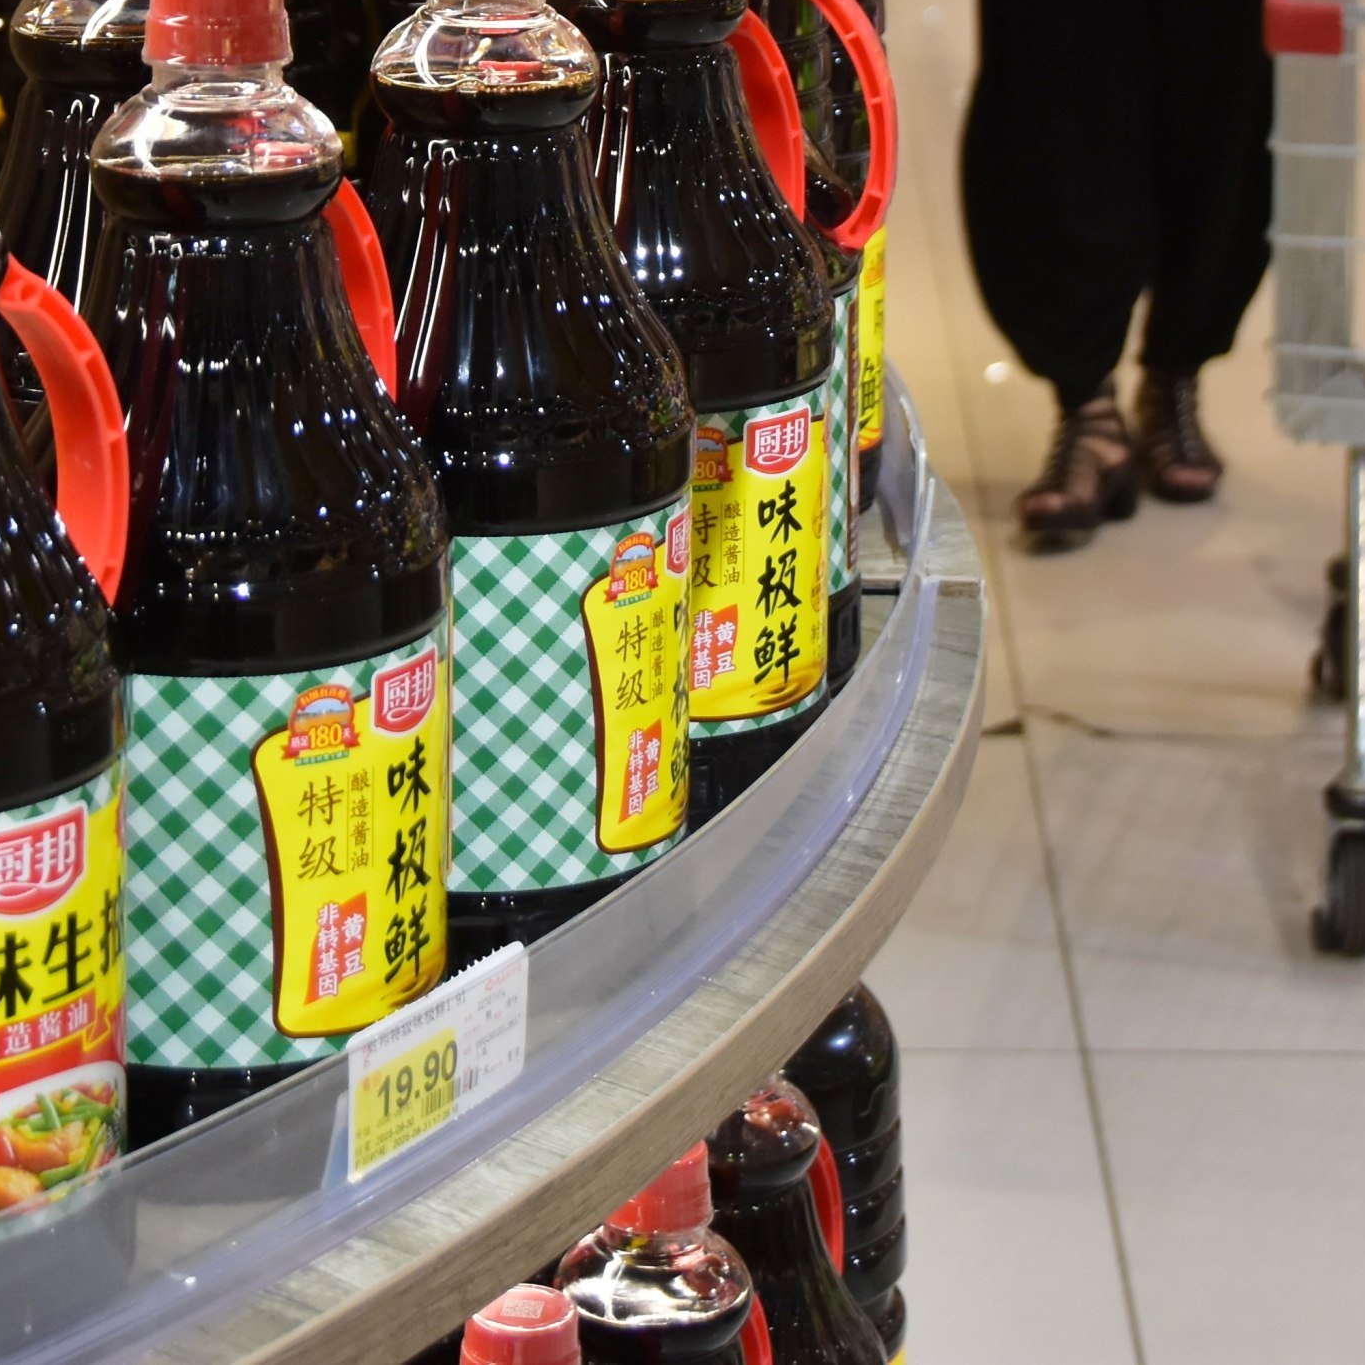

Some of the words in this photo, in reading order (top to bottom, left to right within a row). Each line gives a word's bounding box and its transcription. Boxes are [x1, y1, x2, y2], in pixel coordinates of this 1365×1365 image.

[753, 417, 803, 466] 厨邦
[723, 500, 743, 586] 酿造酱油
[753, 479, 803, 684] 味极鲜
[616, 614, 649, 712] 特级
[651, 608, 666, 699] 酿造酱油
[693, 609, 713, 689] 非转基因
[714, 618, 736, 675] 黄豆
[383, 659, 433, 722] 厨邦
[628, 730, 644, 817] 非转基因
[644, 734, 660, 797] 黄豆
[297, 775, 346, 880] 特级
[349, 771, 370, 871] 酿造酱油
[385, 735, 432, 984] 味极鲜
[318, 902, 340, 997] 非转基因
[341, 913, 366, 978] 黄豆
[378, 1040, 458, 1117] 19.90
